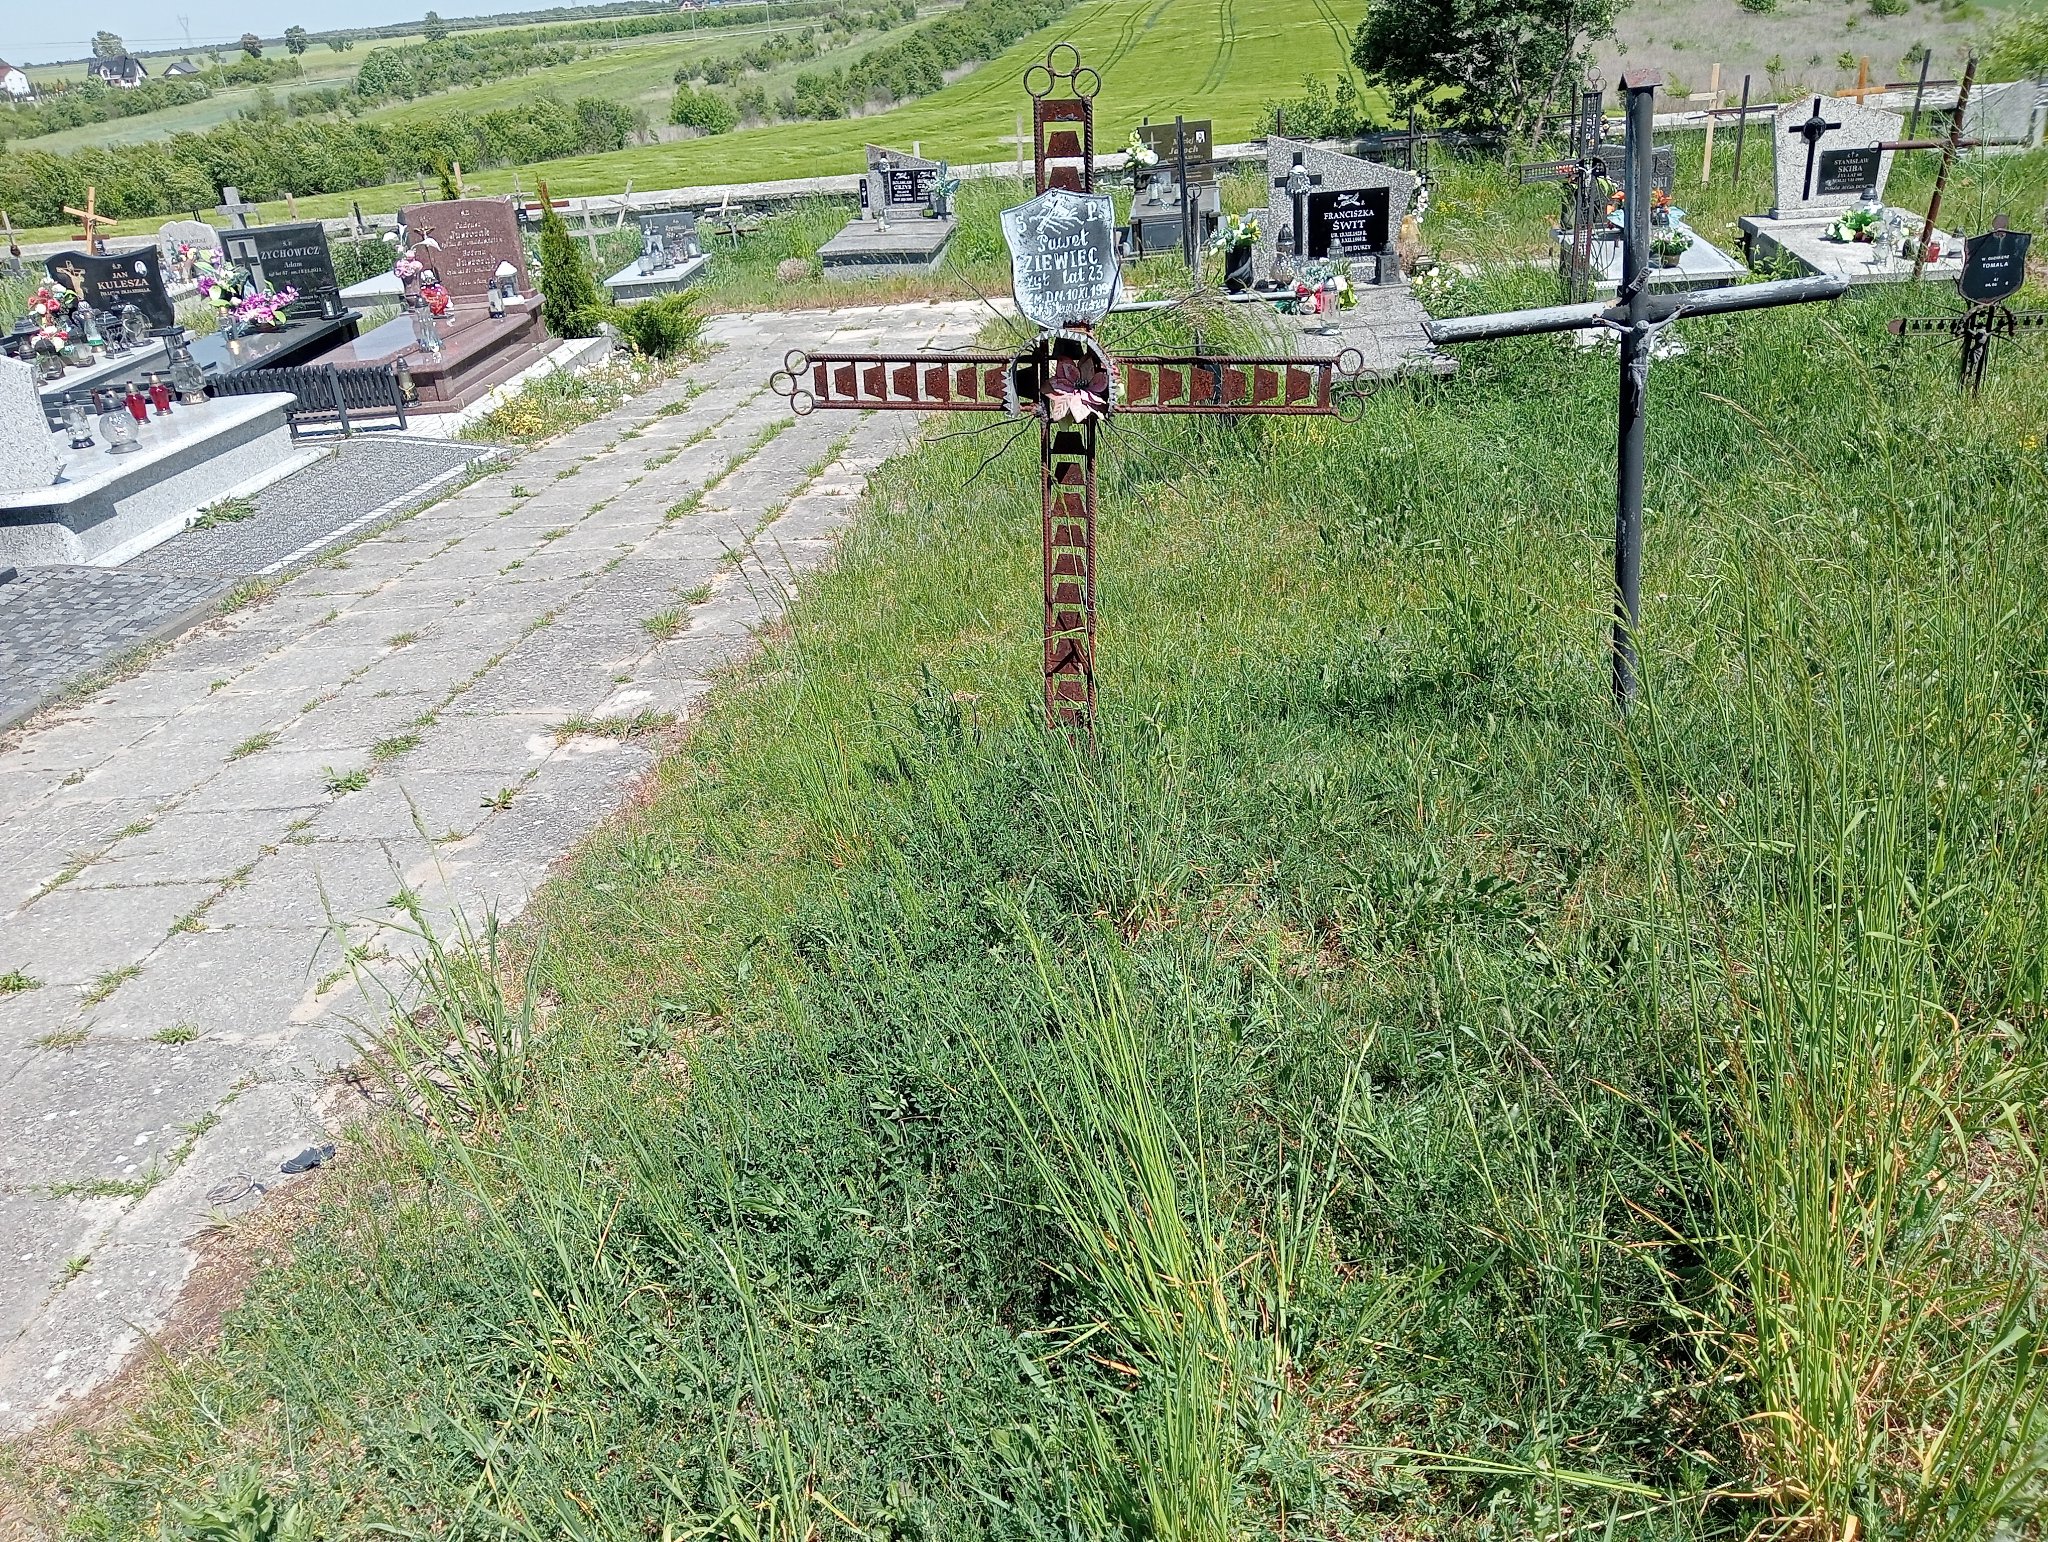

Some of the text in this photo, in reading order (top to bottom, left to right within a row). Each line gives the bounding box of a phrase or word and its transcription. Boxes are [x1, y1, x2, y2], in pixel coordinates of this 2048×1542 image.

[1168, 145, 1199, 155] Jaoch
[1838, 165, 1863, 173] SKIBA
[1323, 209, 1375, 220] FRANCISZKA
[1332, 219, 1366, 231] ŚWIT
[260, 246, 320, 260] ZYCHOWICZ
[1023, 247, 1099, 273] ZIEWIEC
[1982, 261, 2009, 269] TOMALA
[112, 271, 129, 279] JAN
[1088, 265, 1104, 281] 23
[96, 278, 150, 290] KULESZA
